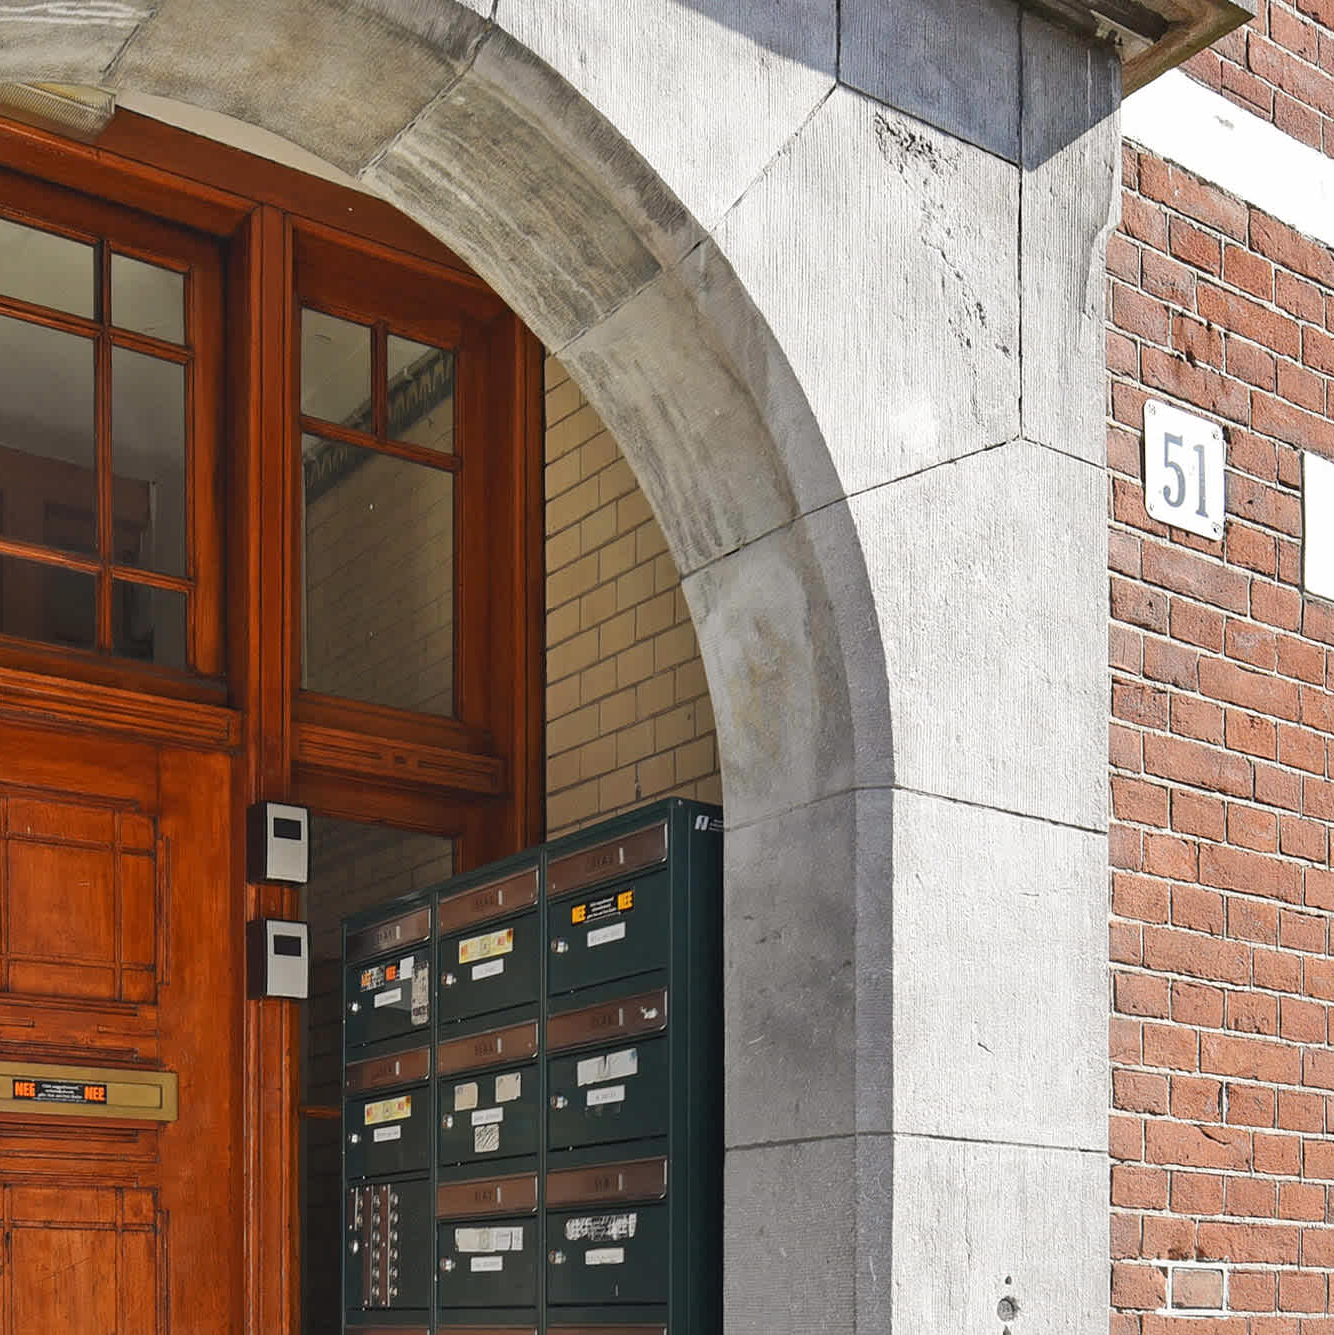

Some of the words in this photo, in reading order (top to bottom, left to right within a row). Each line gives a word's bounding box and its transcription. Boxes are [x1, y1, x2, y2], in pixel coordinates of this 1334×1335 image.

[1163, 432, 1209, 518] 51
[571, 904, 586, 924] NEE
[617, 890, 633, 910] NEE
[14, 1081, 36, 1097] NEE
[85, 1086, 106, 1101] NEE
